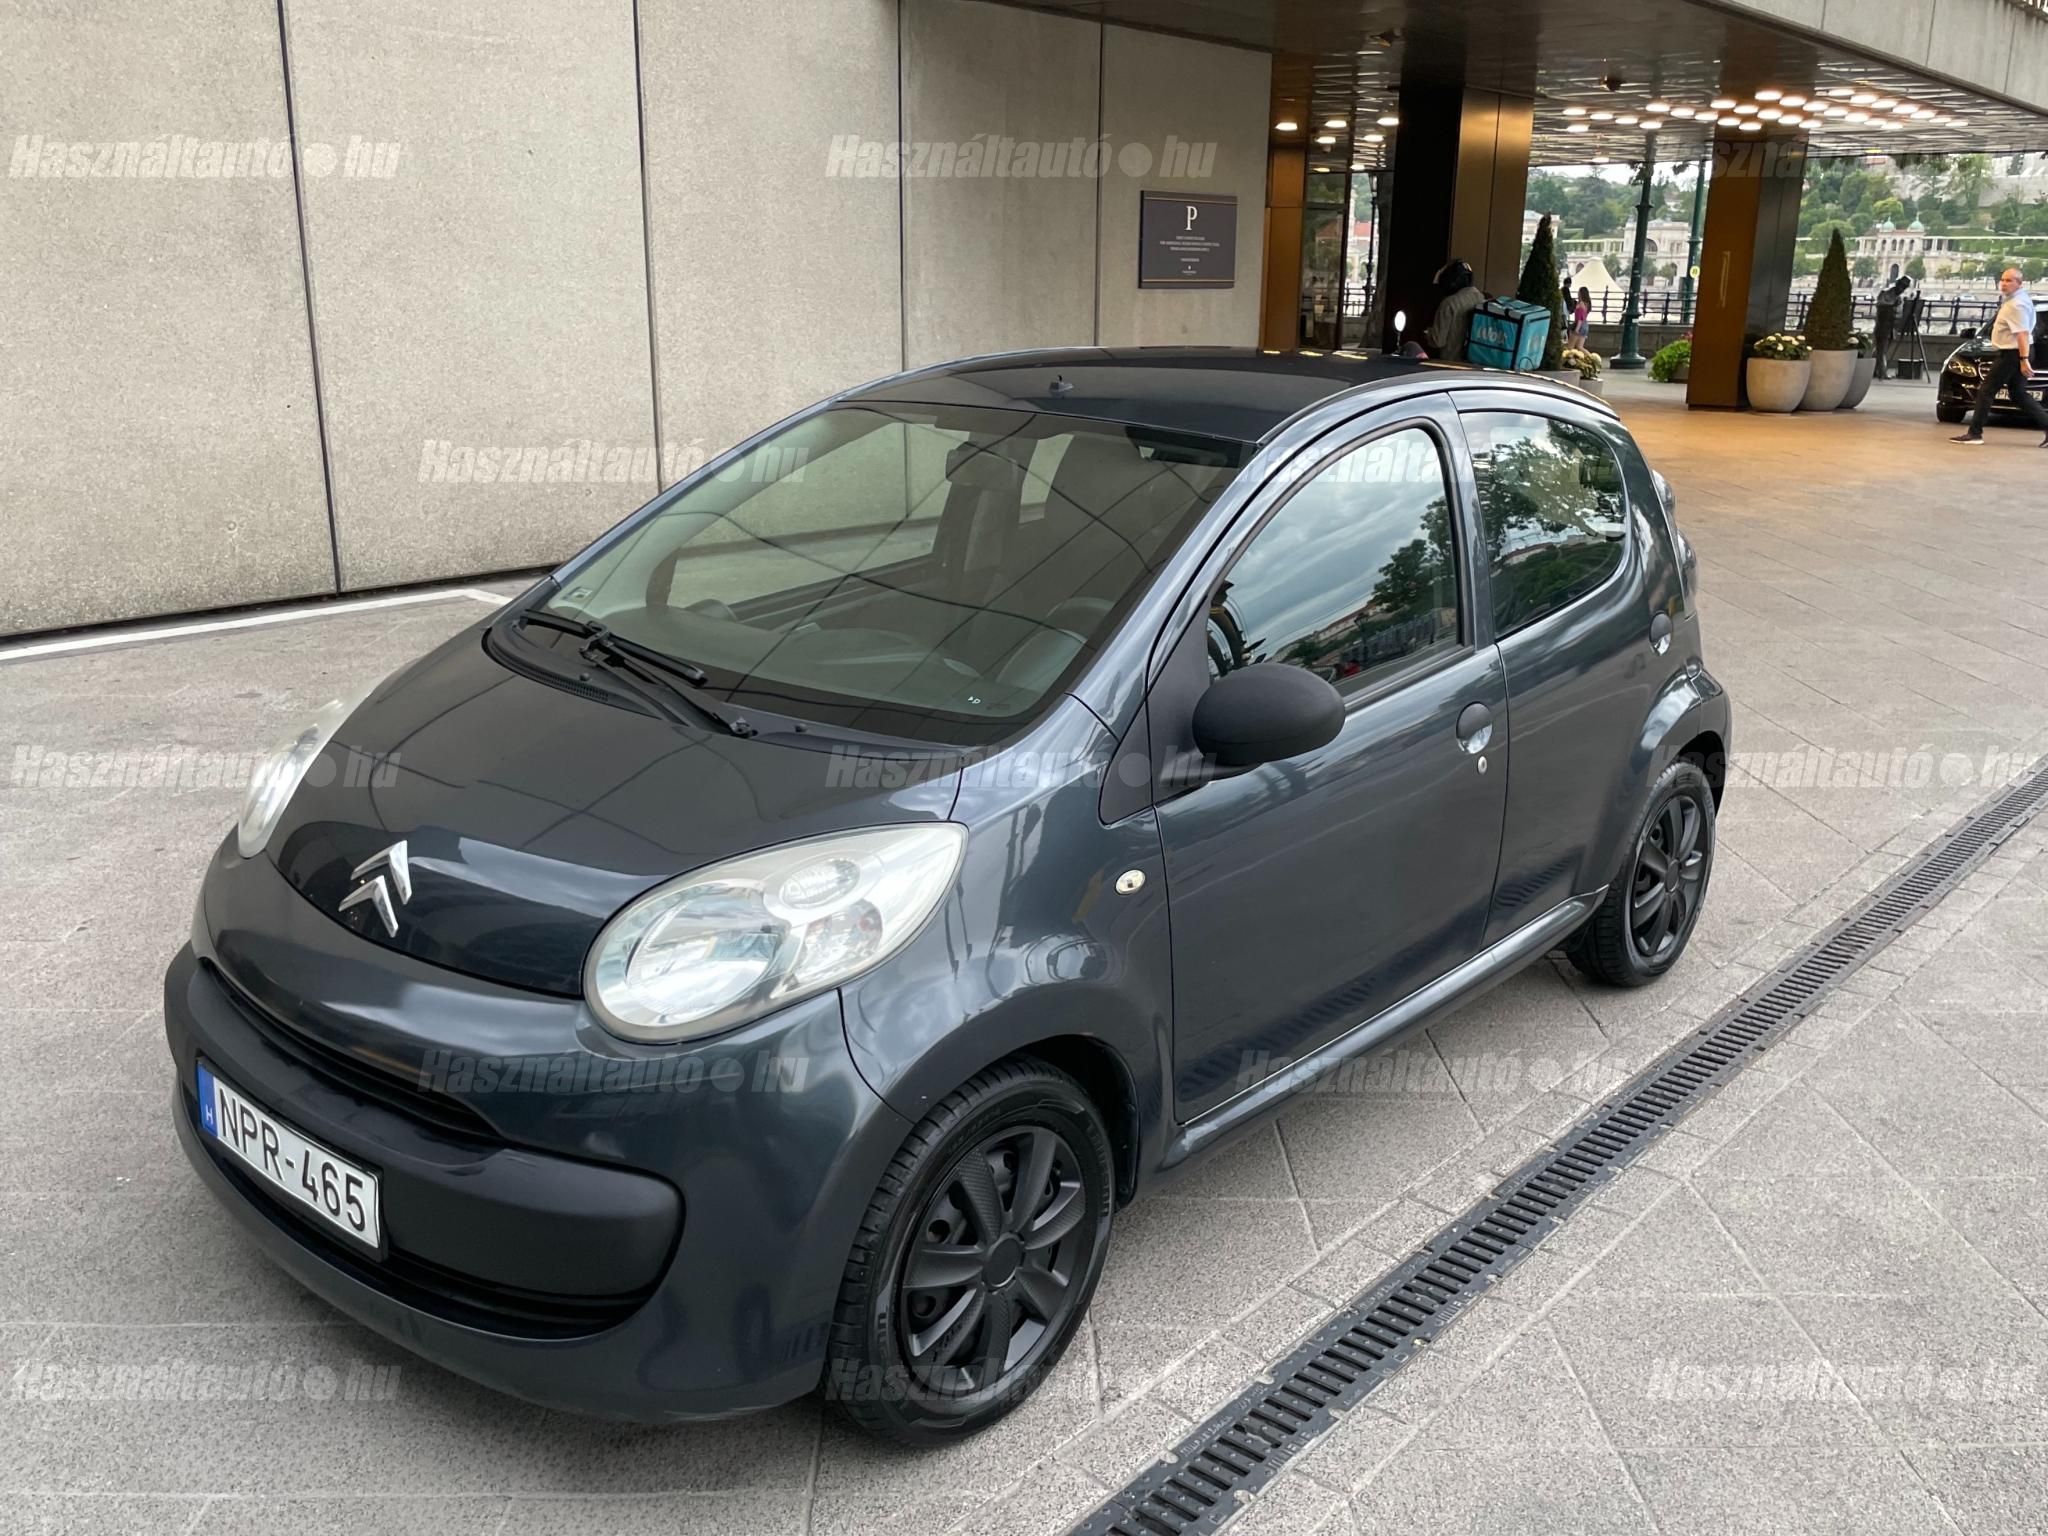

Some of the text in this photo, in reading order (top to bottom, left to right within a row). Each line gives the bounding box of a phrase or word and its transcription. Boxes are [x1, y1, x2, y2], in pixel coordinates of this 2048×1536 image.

[1185, 205, 1198, 231] P
[205, 1088, 366, 1233] H NPR-465
